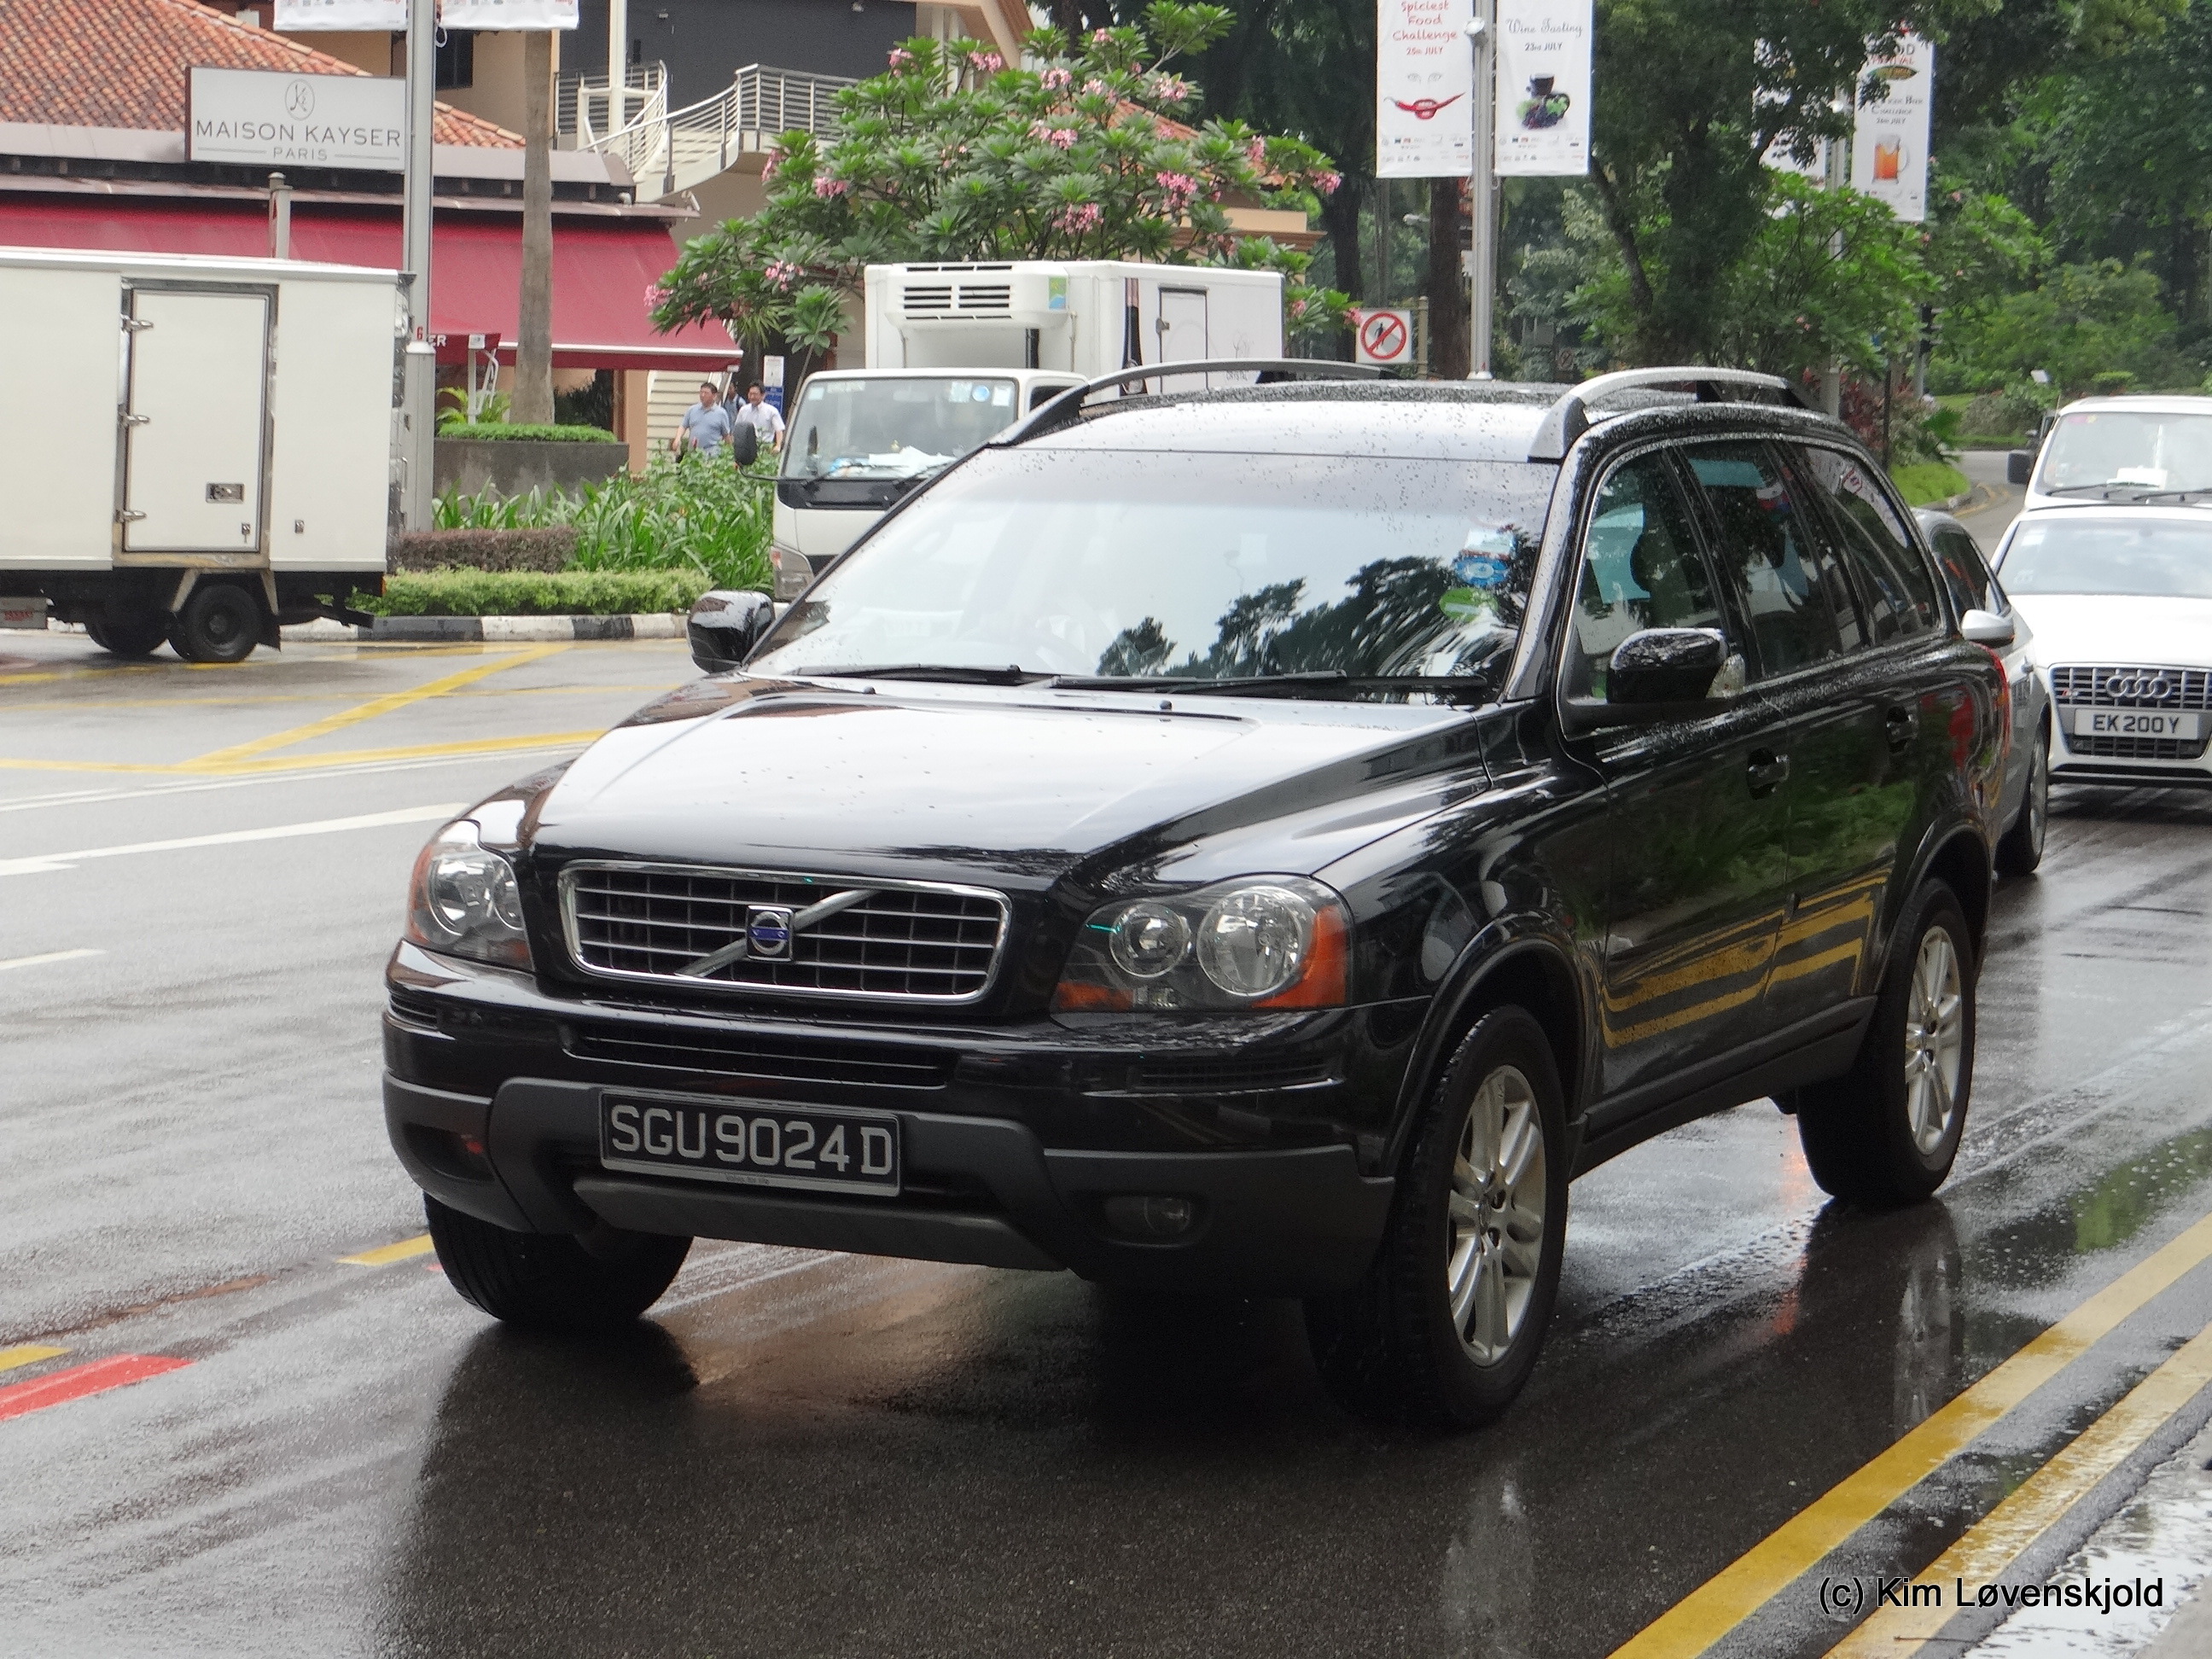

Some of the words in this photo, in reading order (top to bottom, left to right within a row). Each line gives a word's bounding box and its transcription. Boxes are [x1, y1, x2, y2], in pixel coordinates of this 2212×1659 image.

[1400, 0, 1449, 17] Spiciest
[1408, 14, 1442, 26] Food
[1505, 18, 1536, 33] Wine
[1540, 17, 1583, 38] Tasting
[1392, 29, 1458, 43] Challenge
[1424, 46, 1443, 55] JULY
[1544, 42, 1563, 51] JULY
[196, 120, 294, 143] MAISON
[305, 125, 400, 147] KAYSER
[272, 146, 329, 161] PARIS
